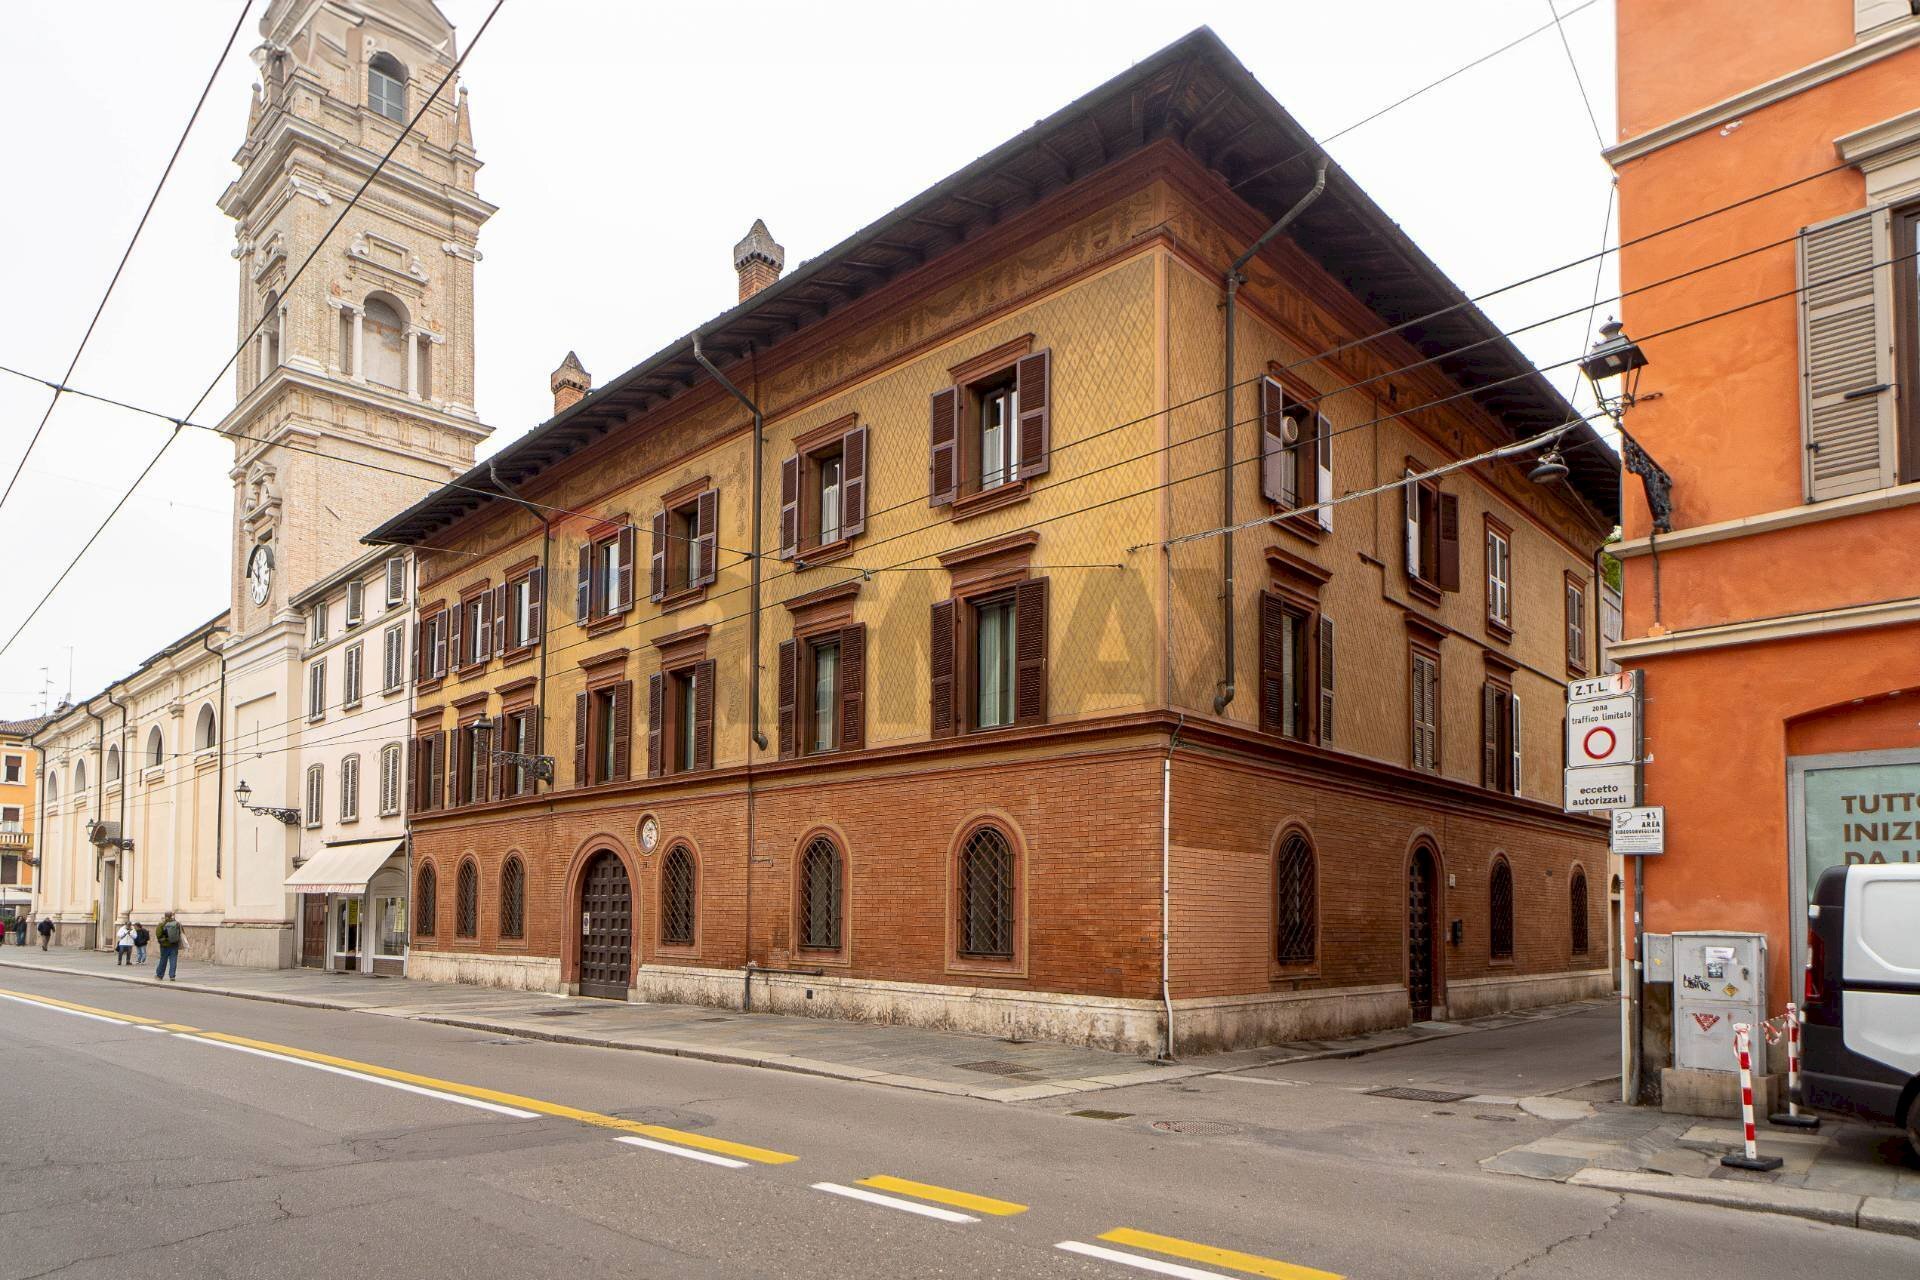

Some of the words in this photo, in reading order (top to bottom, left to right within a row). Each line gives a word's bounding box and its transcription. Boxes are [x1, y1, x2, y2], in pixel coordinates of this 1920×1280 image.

[1575, 682, 1608, 696] Z.T.L.
[1617, 675, 1624, 690] 1
[1592, 704, 1608, 712] zona
[1571, 714, 1599, 725] traffico
[1602, 711, 1632, 721] limitato
[1580, 785, 1618, 795] eccetto
[1572, 795, 1626, 806] autorizzati
[1841, 793, 1920, 814] TUTT
